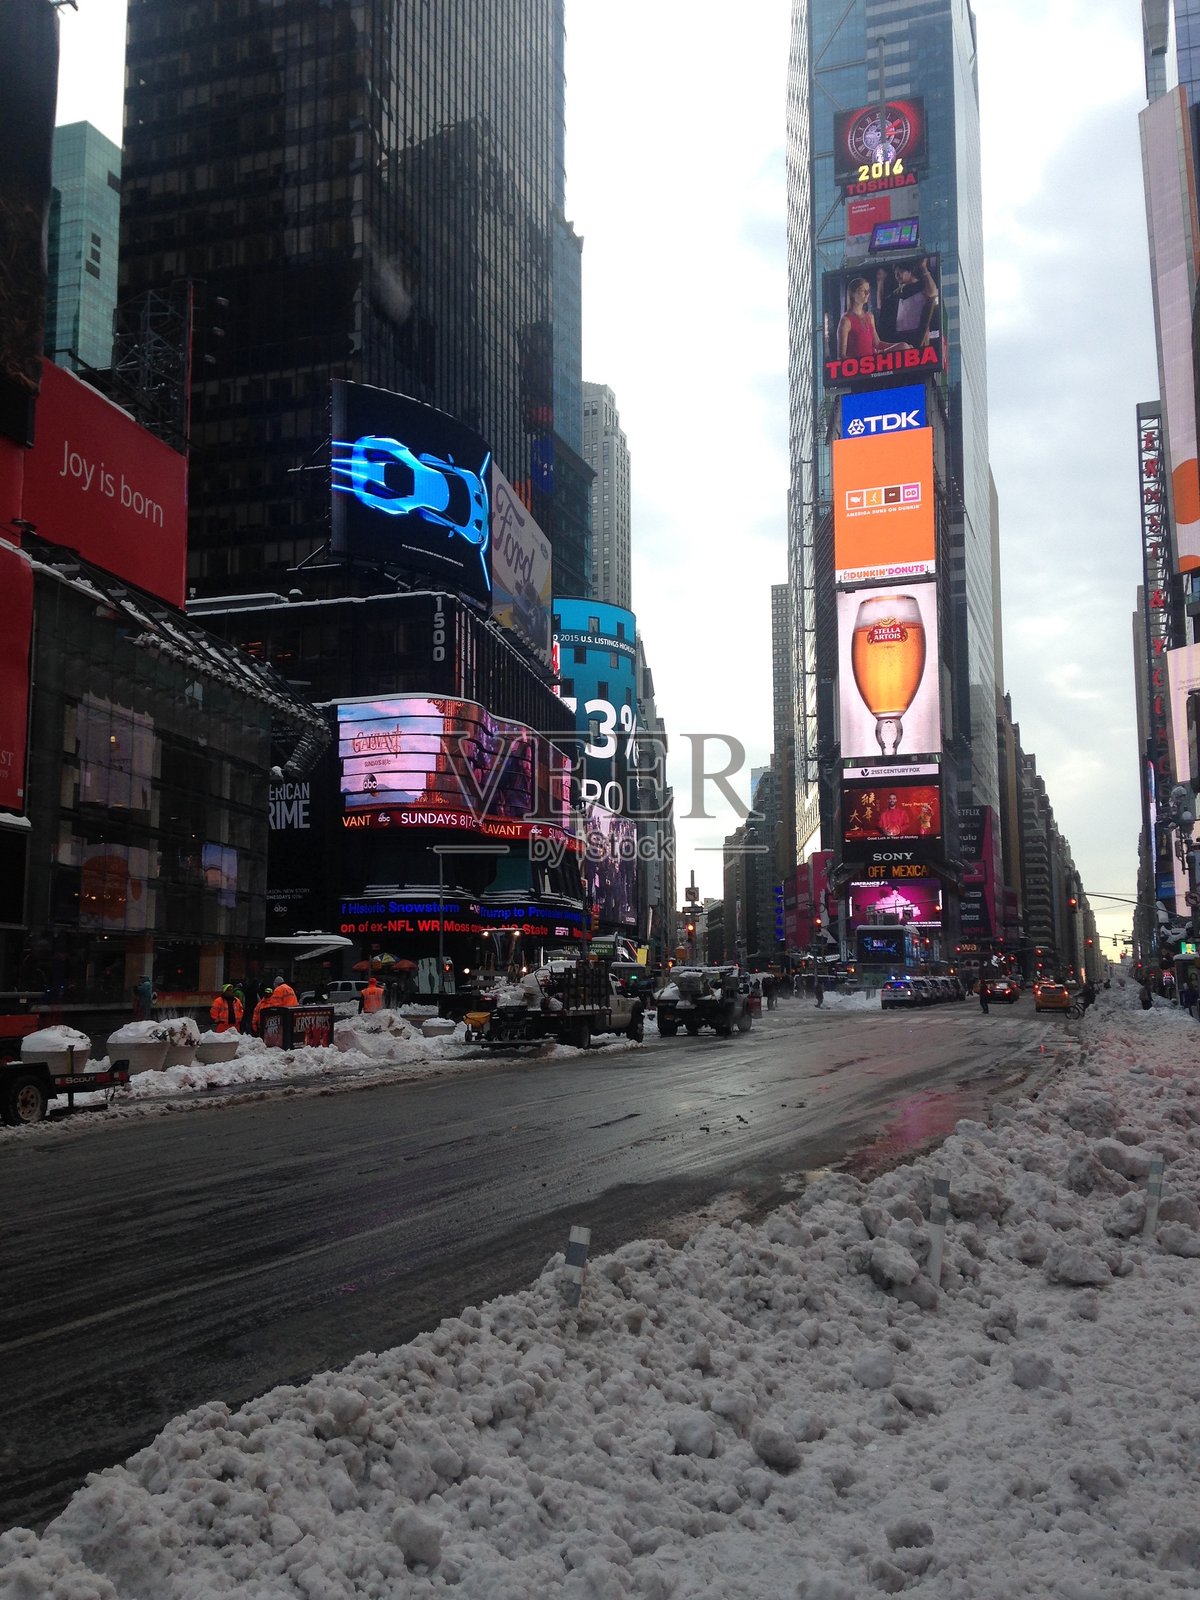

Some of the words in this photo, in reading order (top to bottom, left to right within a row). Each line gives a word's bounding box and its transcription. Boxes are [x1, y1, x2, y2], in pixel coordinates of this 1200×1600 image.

[857, 158, 905, 182] 2016
[847, 174, 917, 196] TOSHIBA
[825, 346, 939, 379] TOSHIBA
[863, 409, 921, 433] TDK
[59, 440, 96, 492] Joy
[100, 462, 115, 498] is
[120, 473, 163, 529] born
[846, 510, 871, 518] AMERICA
[432, 596, 446, 662] 1500
[874, 627, 901, 635] STELLA
[874, 633, 901, 641] ARTOIS
[560, 633, 580, 642] 2015
[580, 635, 594, 644] U.S.
[594, 637, 620, 648] LISTINGS
[363, 778, 377, 789] abc
[342, 815, 372, 828] VANT
[378, 812, 391, 823] abc
[401, 813, 458, 826] SUNDAYS
[873, 852, 914, 861] SONY
[868, 865, 886, 878] OFF
[891, 864, 928, 877] MEXICA
[348, 902, 386, 914] Historic
[388, 901, 460, 913] Snowstorm
[480, 906, 512, 920] Trump
[513, 906, 525, 918] to
[340, 923, 356, 933] on
[358, 921, 369, 933] of
[371, 920, 414, 932] ex-NFL
[417, 920, 441, 932] WR
[444, 920, 470, 933] Moss
[523, 923, 549, 937] State
[65, 1076, 96, 1085] SCOUT
